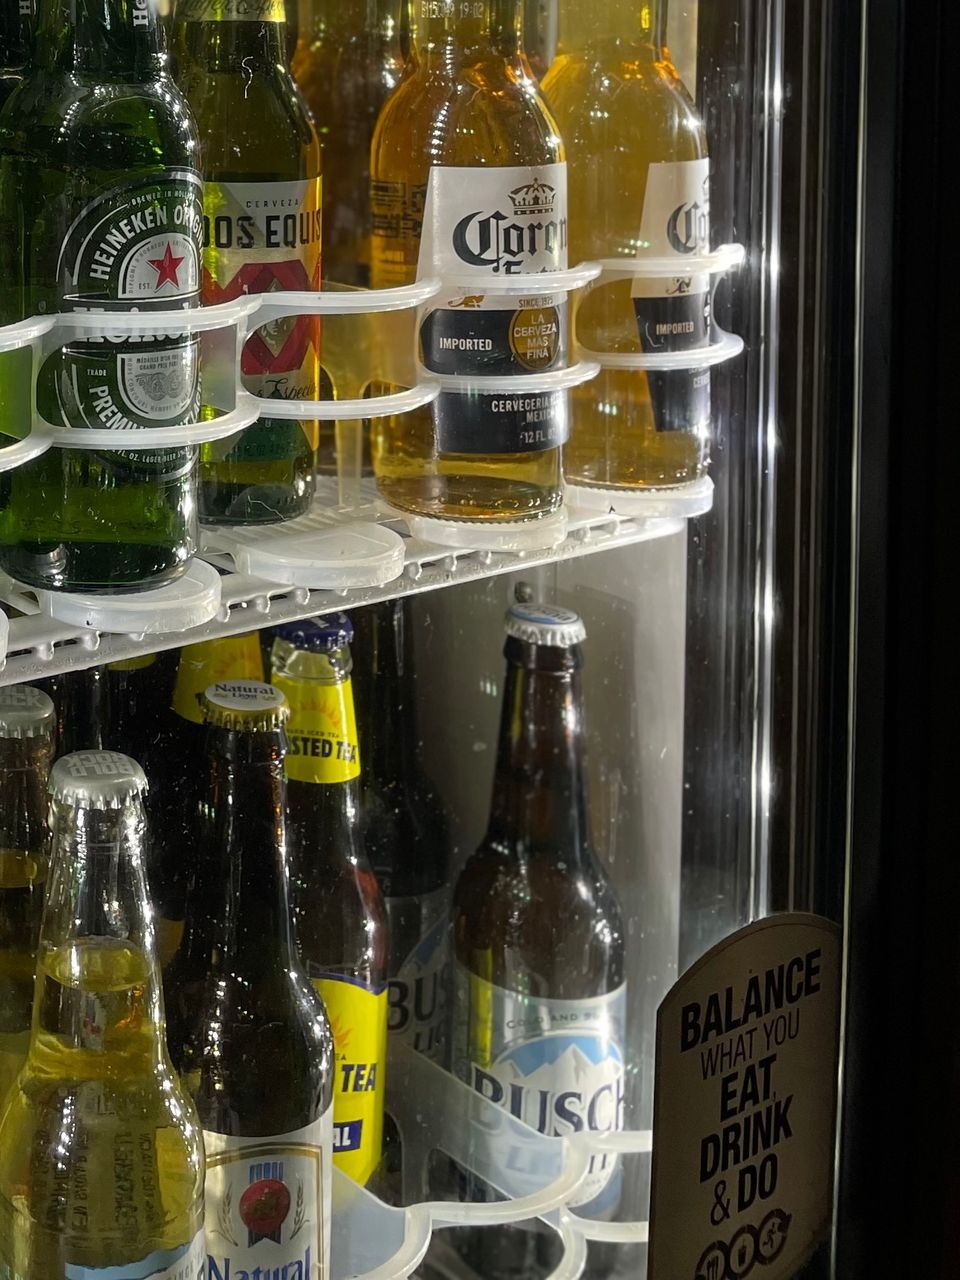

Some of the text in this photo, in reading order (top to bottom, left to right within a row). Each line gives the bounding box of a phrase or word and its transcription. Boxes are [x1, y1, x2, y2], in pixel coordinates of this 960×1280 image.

[246, 200, 299, 209] CERVEZA
[265, 209, 321, 248] EQUIS
[90, 207, 168, 281] HEINEKEN
[518, 298, 540, 308] SINCE
[531, 314, 545, 325] LA
[513, 324, 558, 337] CERVEZA
[655, 321, 695, 336] IMPORTED
[439, 337, 493, 351] IMPORTED
[526, 347, 550, 361] FINA
[214, 683, 275, 696] Natural
[66, 753, 129, 766] ROCK
[336, 741, 358, 764] TEA
[70, 762, 134, 776] BOLD
[680, 948, 822, 1053] BALANCE
[700, 1008, 800, 1080] WHAT YOU
[342, 1062, 377, 1093] TEA
[720, 1054, 778, 1123] EAT,
[700, 1094, 794, 1184] DRINK
[710, 1152, 778, 1226] & DO
